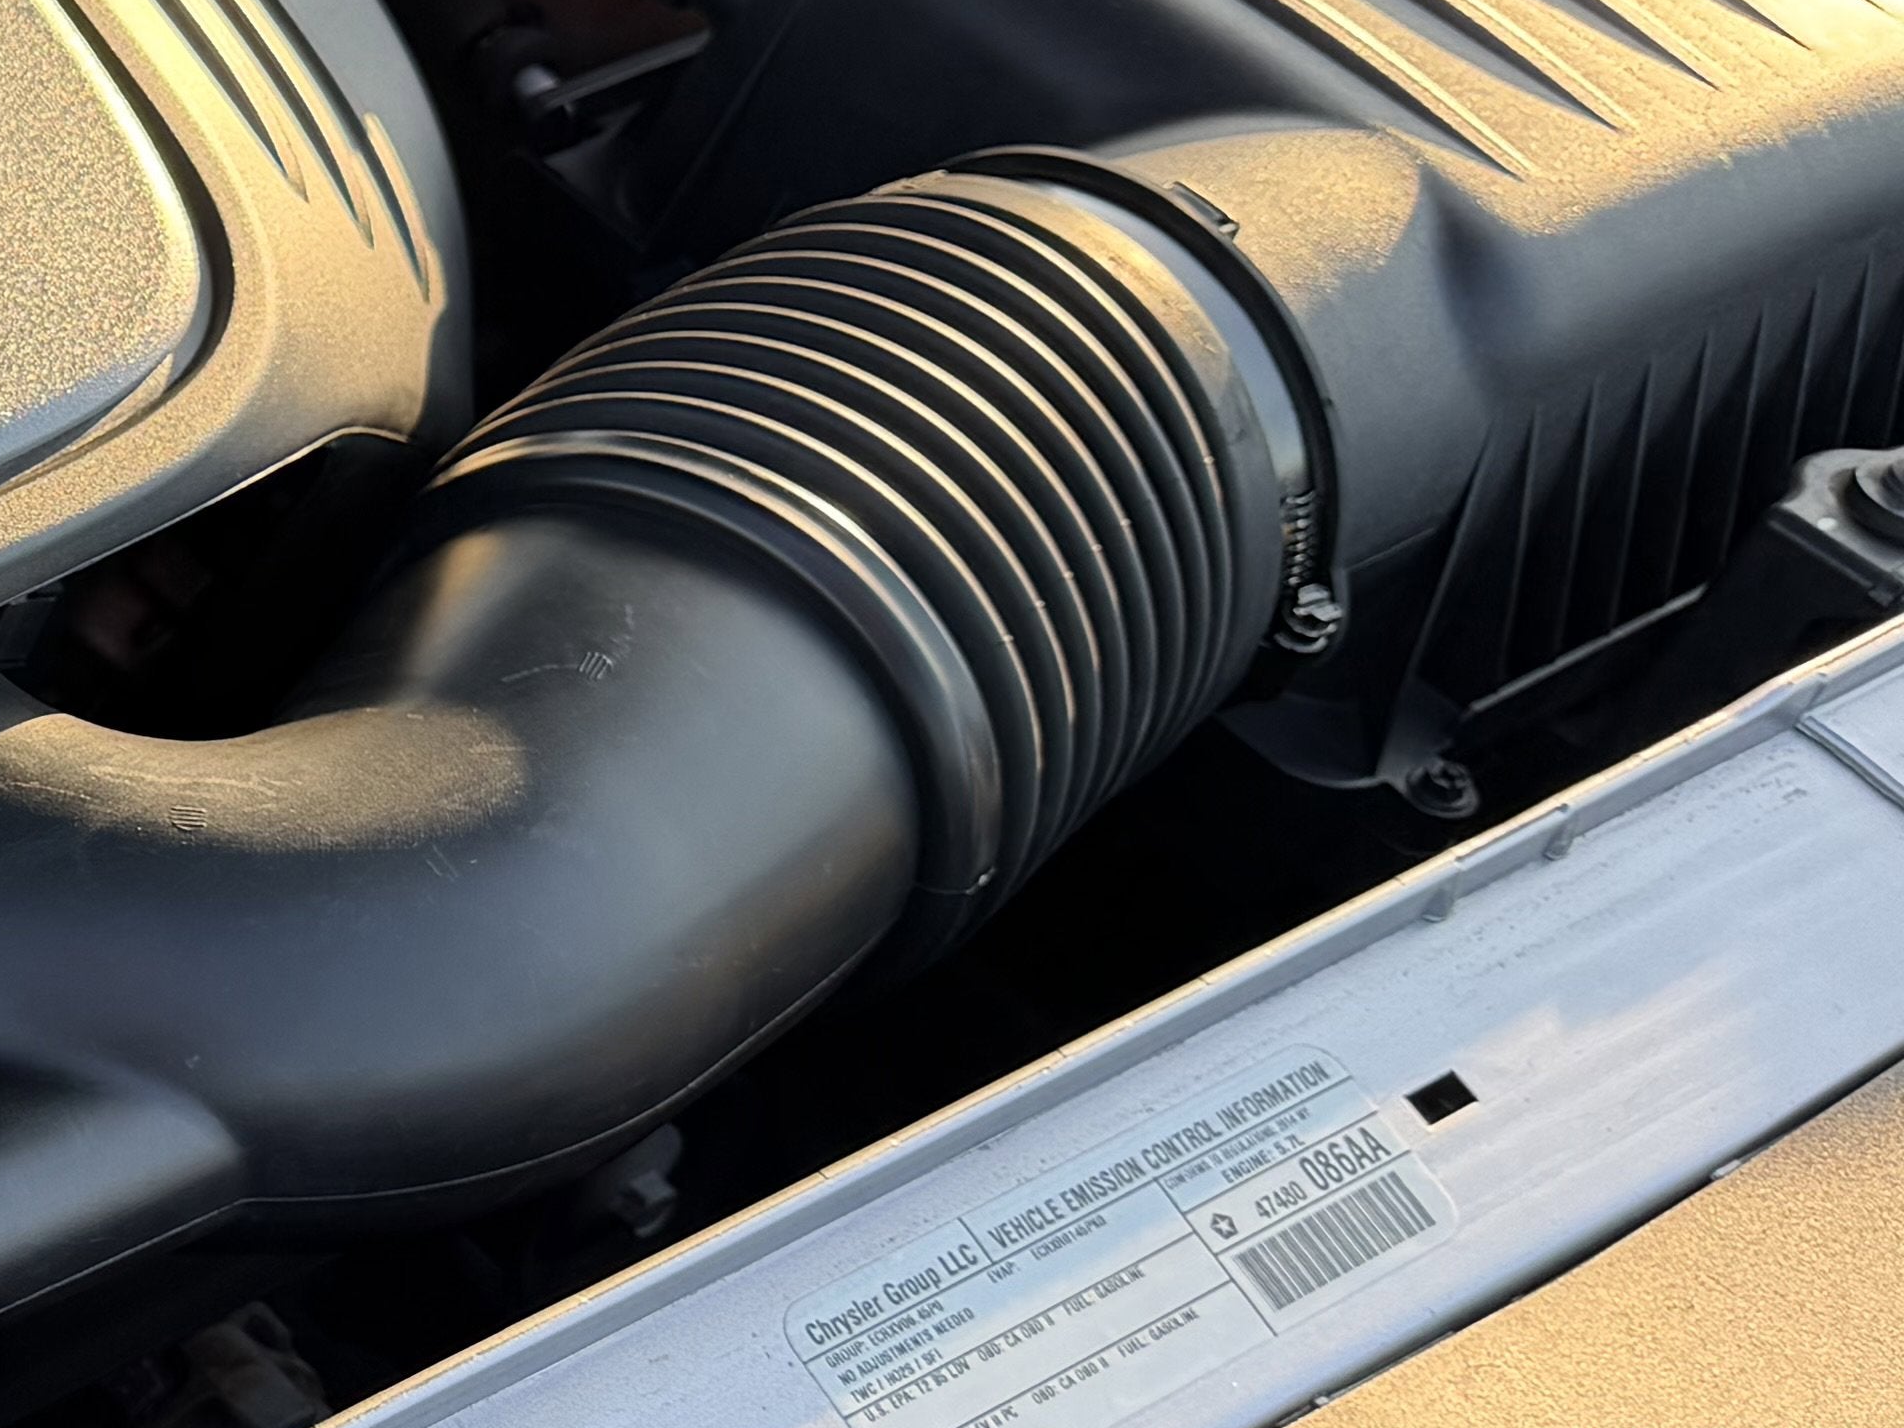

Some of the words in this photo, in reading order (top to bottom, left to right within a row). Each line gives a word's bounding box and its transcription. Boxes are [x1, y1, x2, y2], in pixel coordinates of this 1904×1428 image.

[987, 1197, 1065, 1249] VEHICLE
[1059, 1156, 1146, 1212] EMISSION
[1142, 1117, 1223, 1171] CONTROL
[1215, 1060, 1331, 1131] INFORMATION
[1221, 1149, 1273, 1184] ENGINE:
[805, 1296, 884, 1345] Chrysler
[882, 1266, 942, 1306] Group
[937, 1243, 978, 1277] LLC
[986, 1260, 1021, 1284] EVAP:
[1061, 1288, 1095, 1317] FUEL:
[1093, 1264, 1146, 1300] GASOLINE
[825, 1339, 871, 1369] GROUP:
[837, 1368, 856, 1387] NO
[860, 1328, 934, 1375] ADJUSTMENTS
[932, 1307, 975, 1339] NEEDED
[1116, 1335, 1149, 1359] FUEL:
[1147, 1306, 1201, 1341] GASOLINE
[850, 1378, 878, 1405] TWC
[923, 1347, 943, 1367] SFI
[863, 1400, 891, 1422] U.S.
[891, 1385, 917, 1410] EPA:
[1003, 1331, 1022, 1349] CA
[1057, 1373, 1077, 1391] CA
